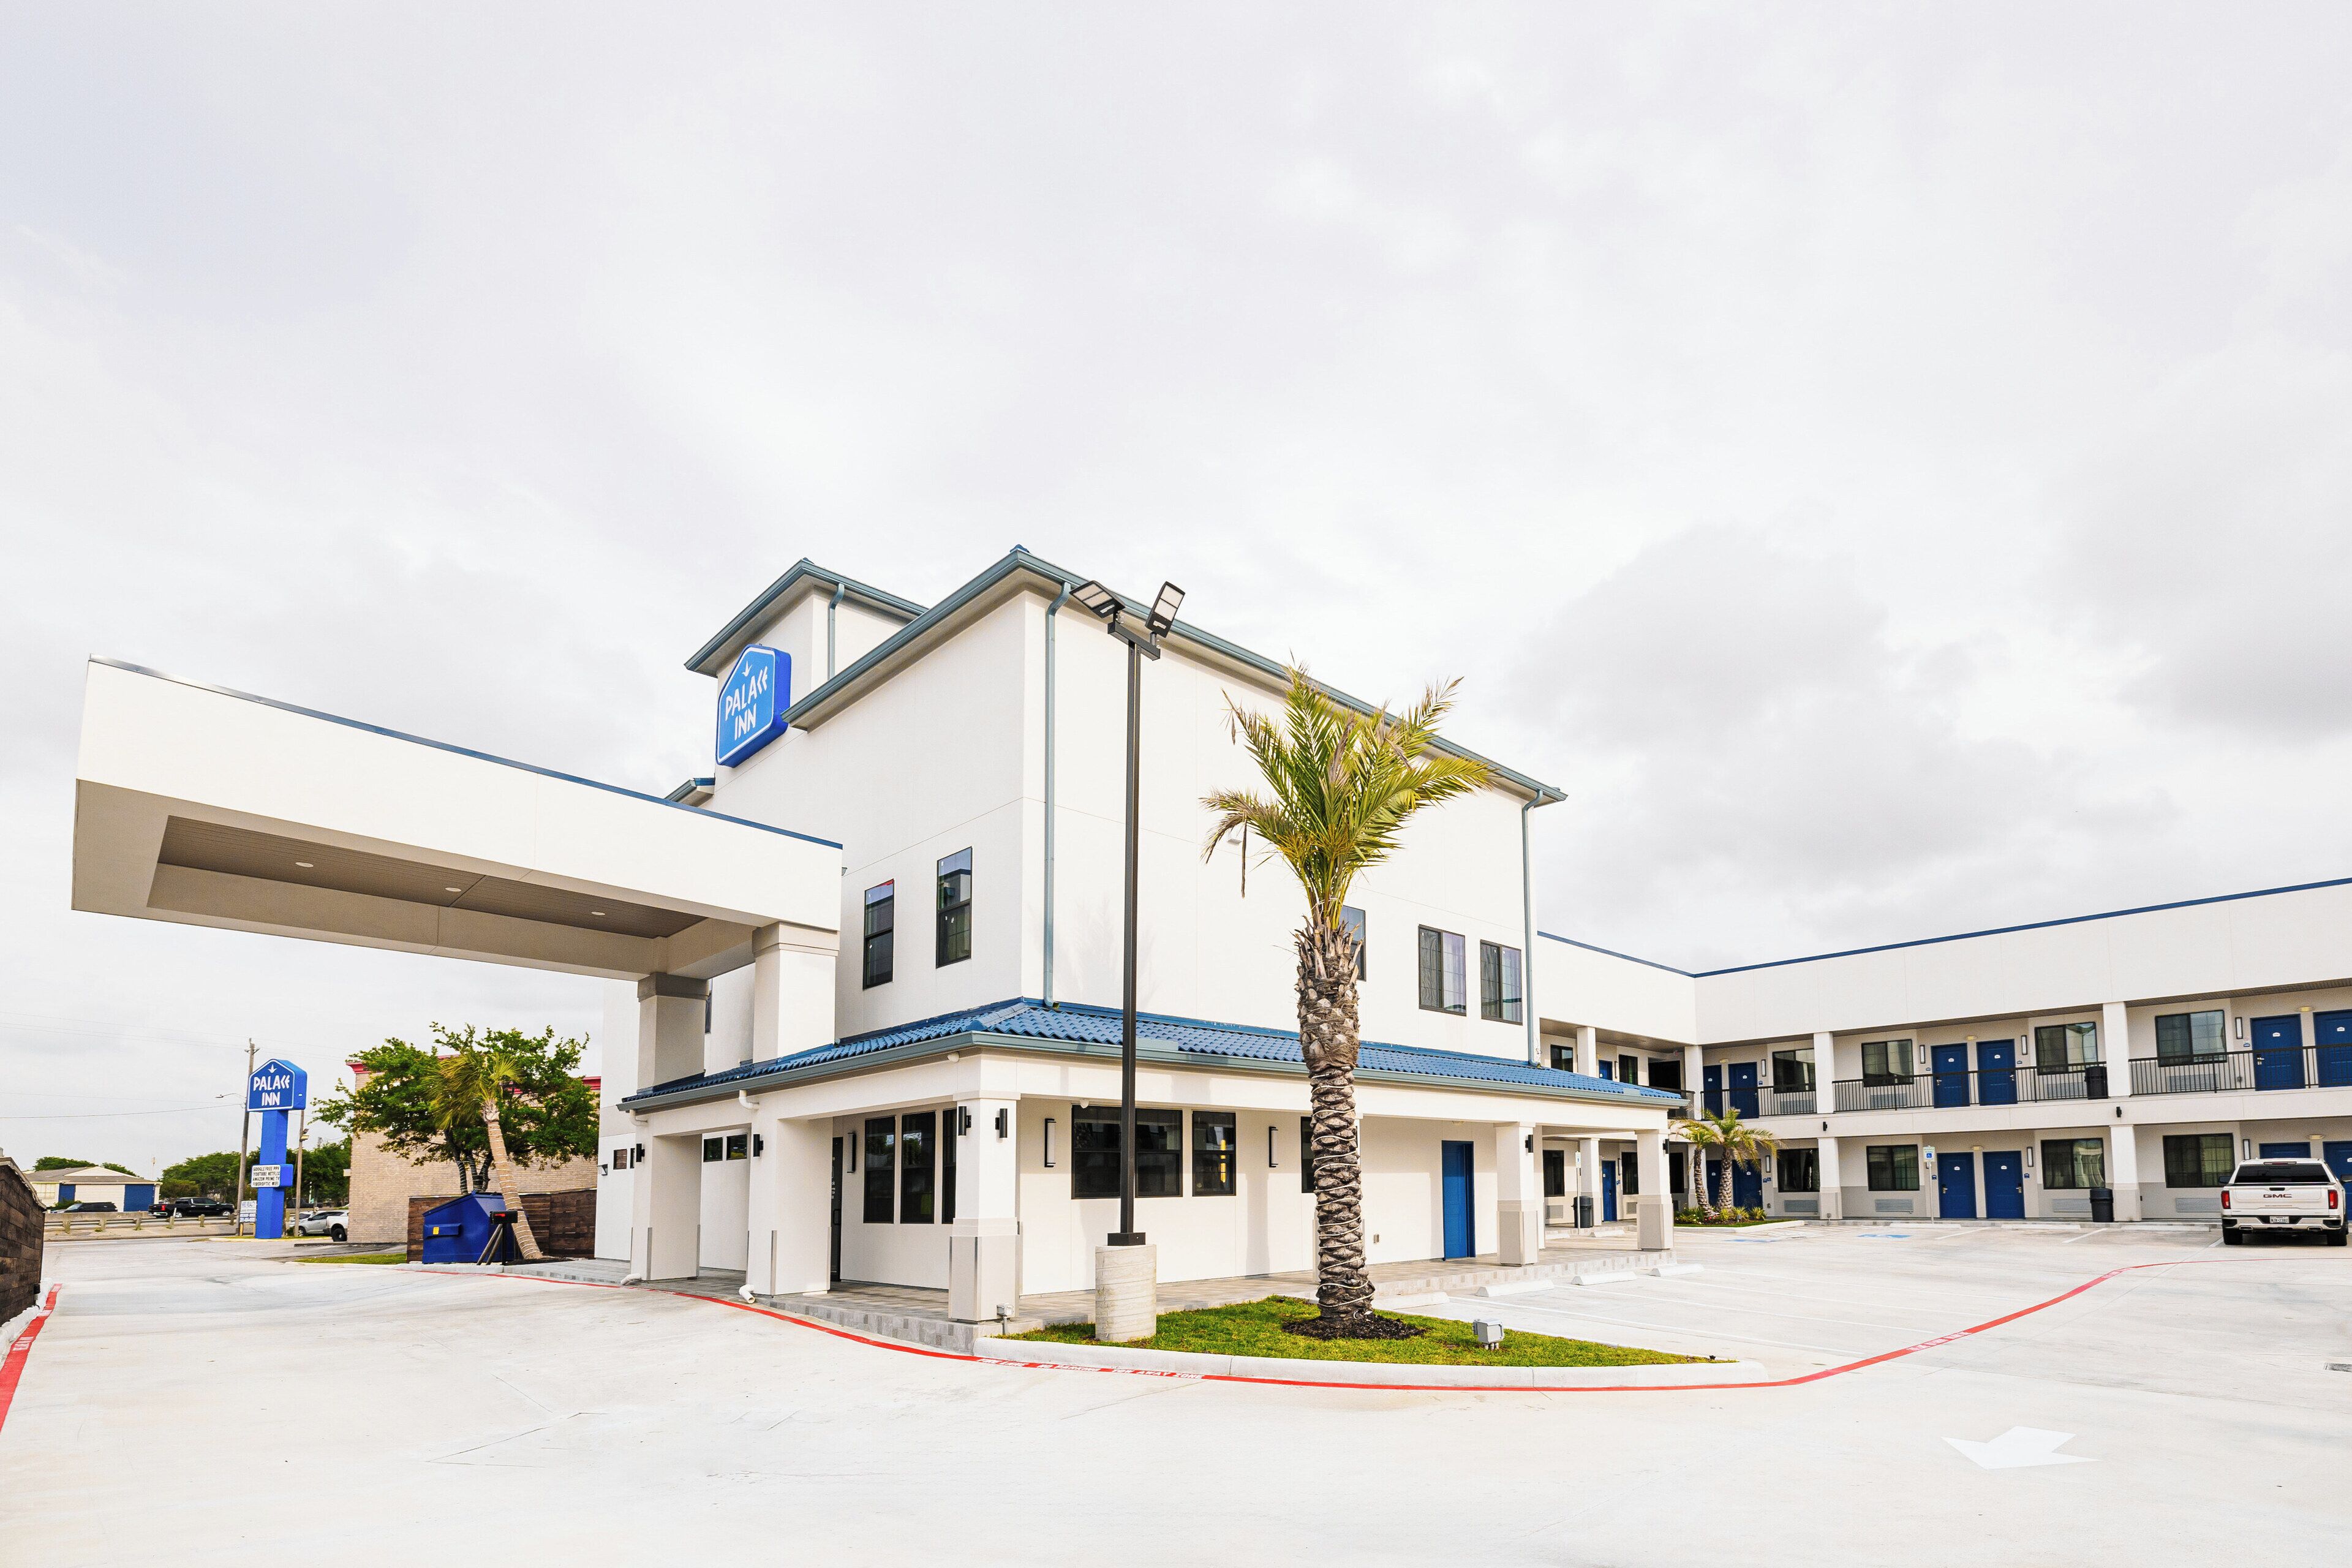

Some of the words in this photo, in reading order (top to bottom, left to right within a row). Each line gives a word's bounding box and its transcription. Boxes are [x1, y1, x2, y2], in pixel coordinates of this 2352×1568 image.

[725, 666, 767, 721] PALACE
[734, 703, 757, 741] INN
[253, 1074, 290, 1091] PALACE
[261, 1091, 281, 1106] INN
